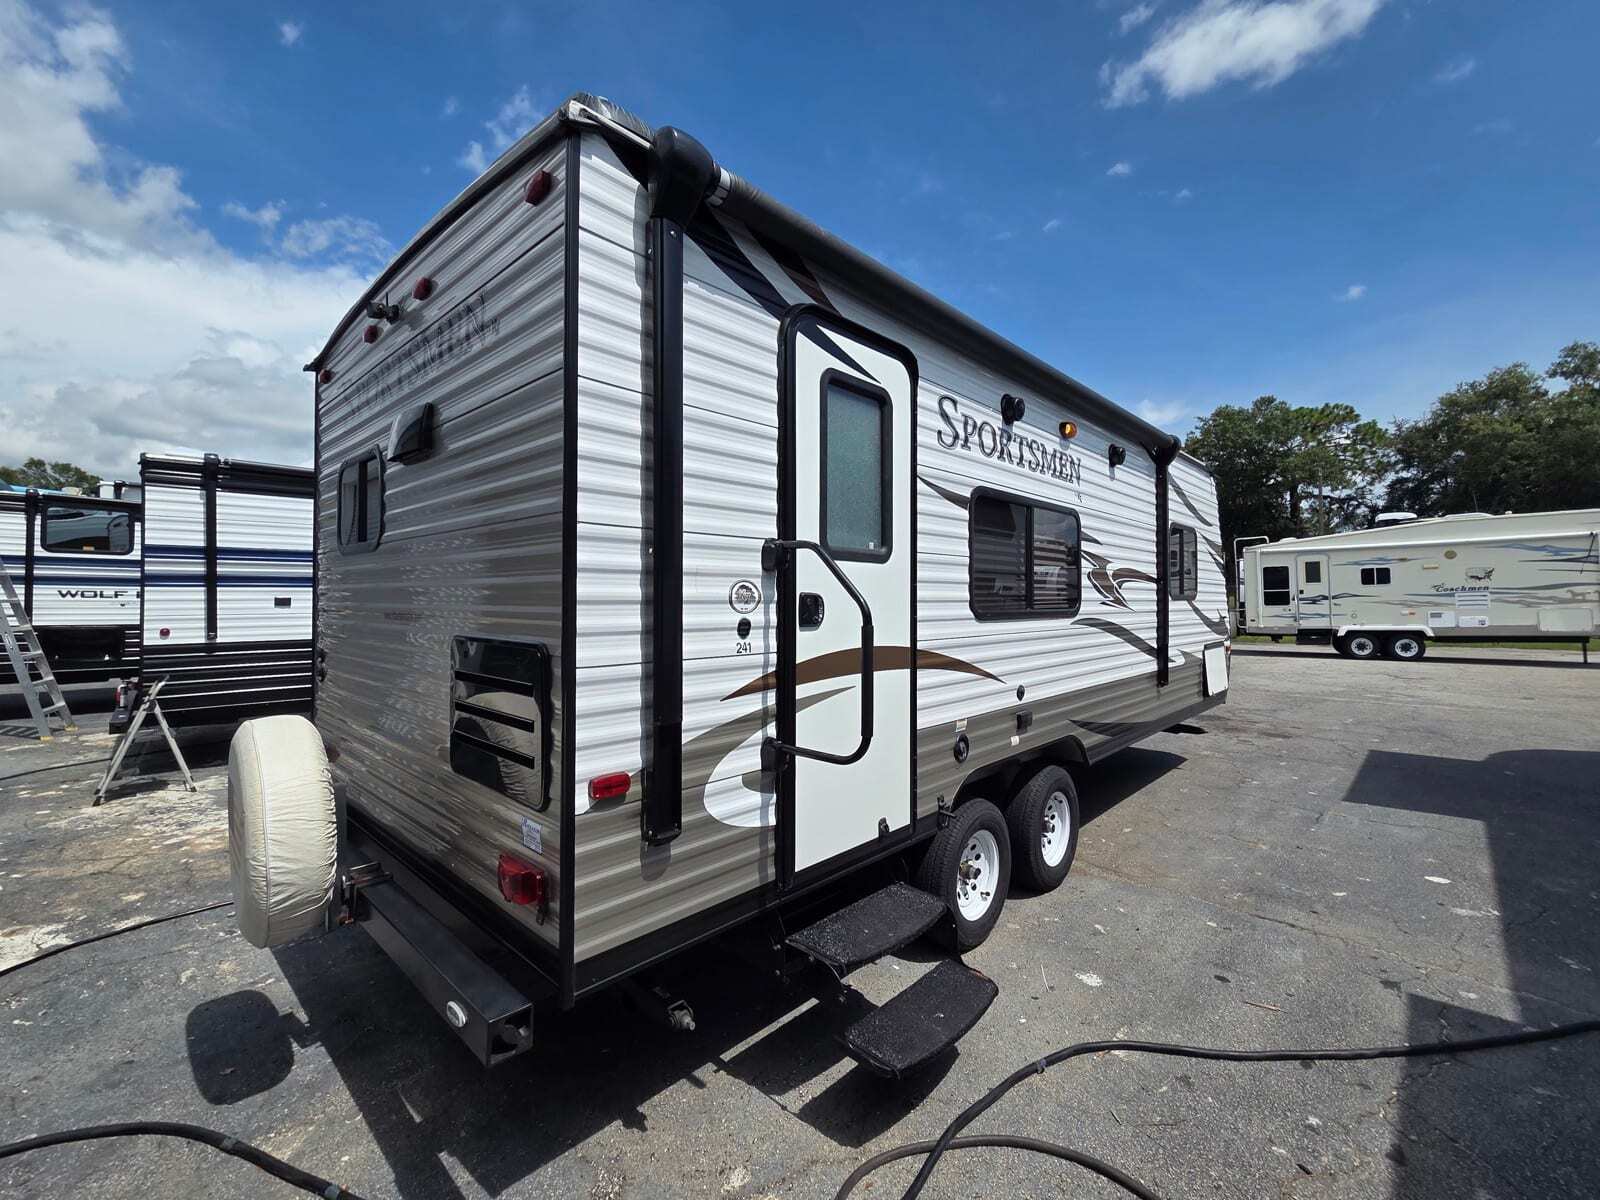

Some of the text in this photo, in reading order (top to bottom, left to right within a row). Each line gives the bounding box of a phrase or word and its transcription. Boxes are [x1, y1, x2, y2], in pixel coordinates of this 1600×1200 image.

[936, 395, 1082, 486] SPORTSMEN
[57, 590, 129, 599] WOLF
[736, 642, 752, 654] 241
